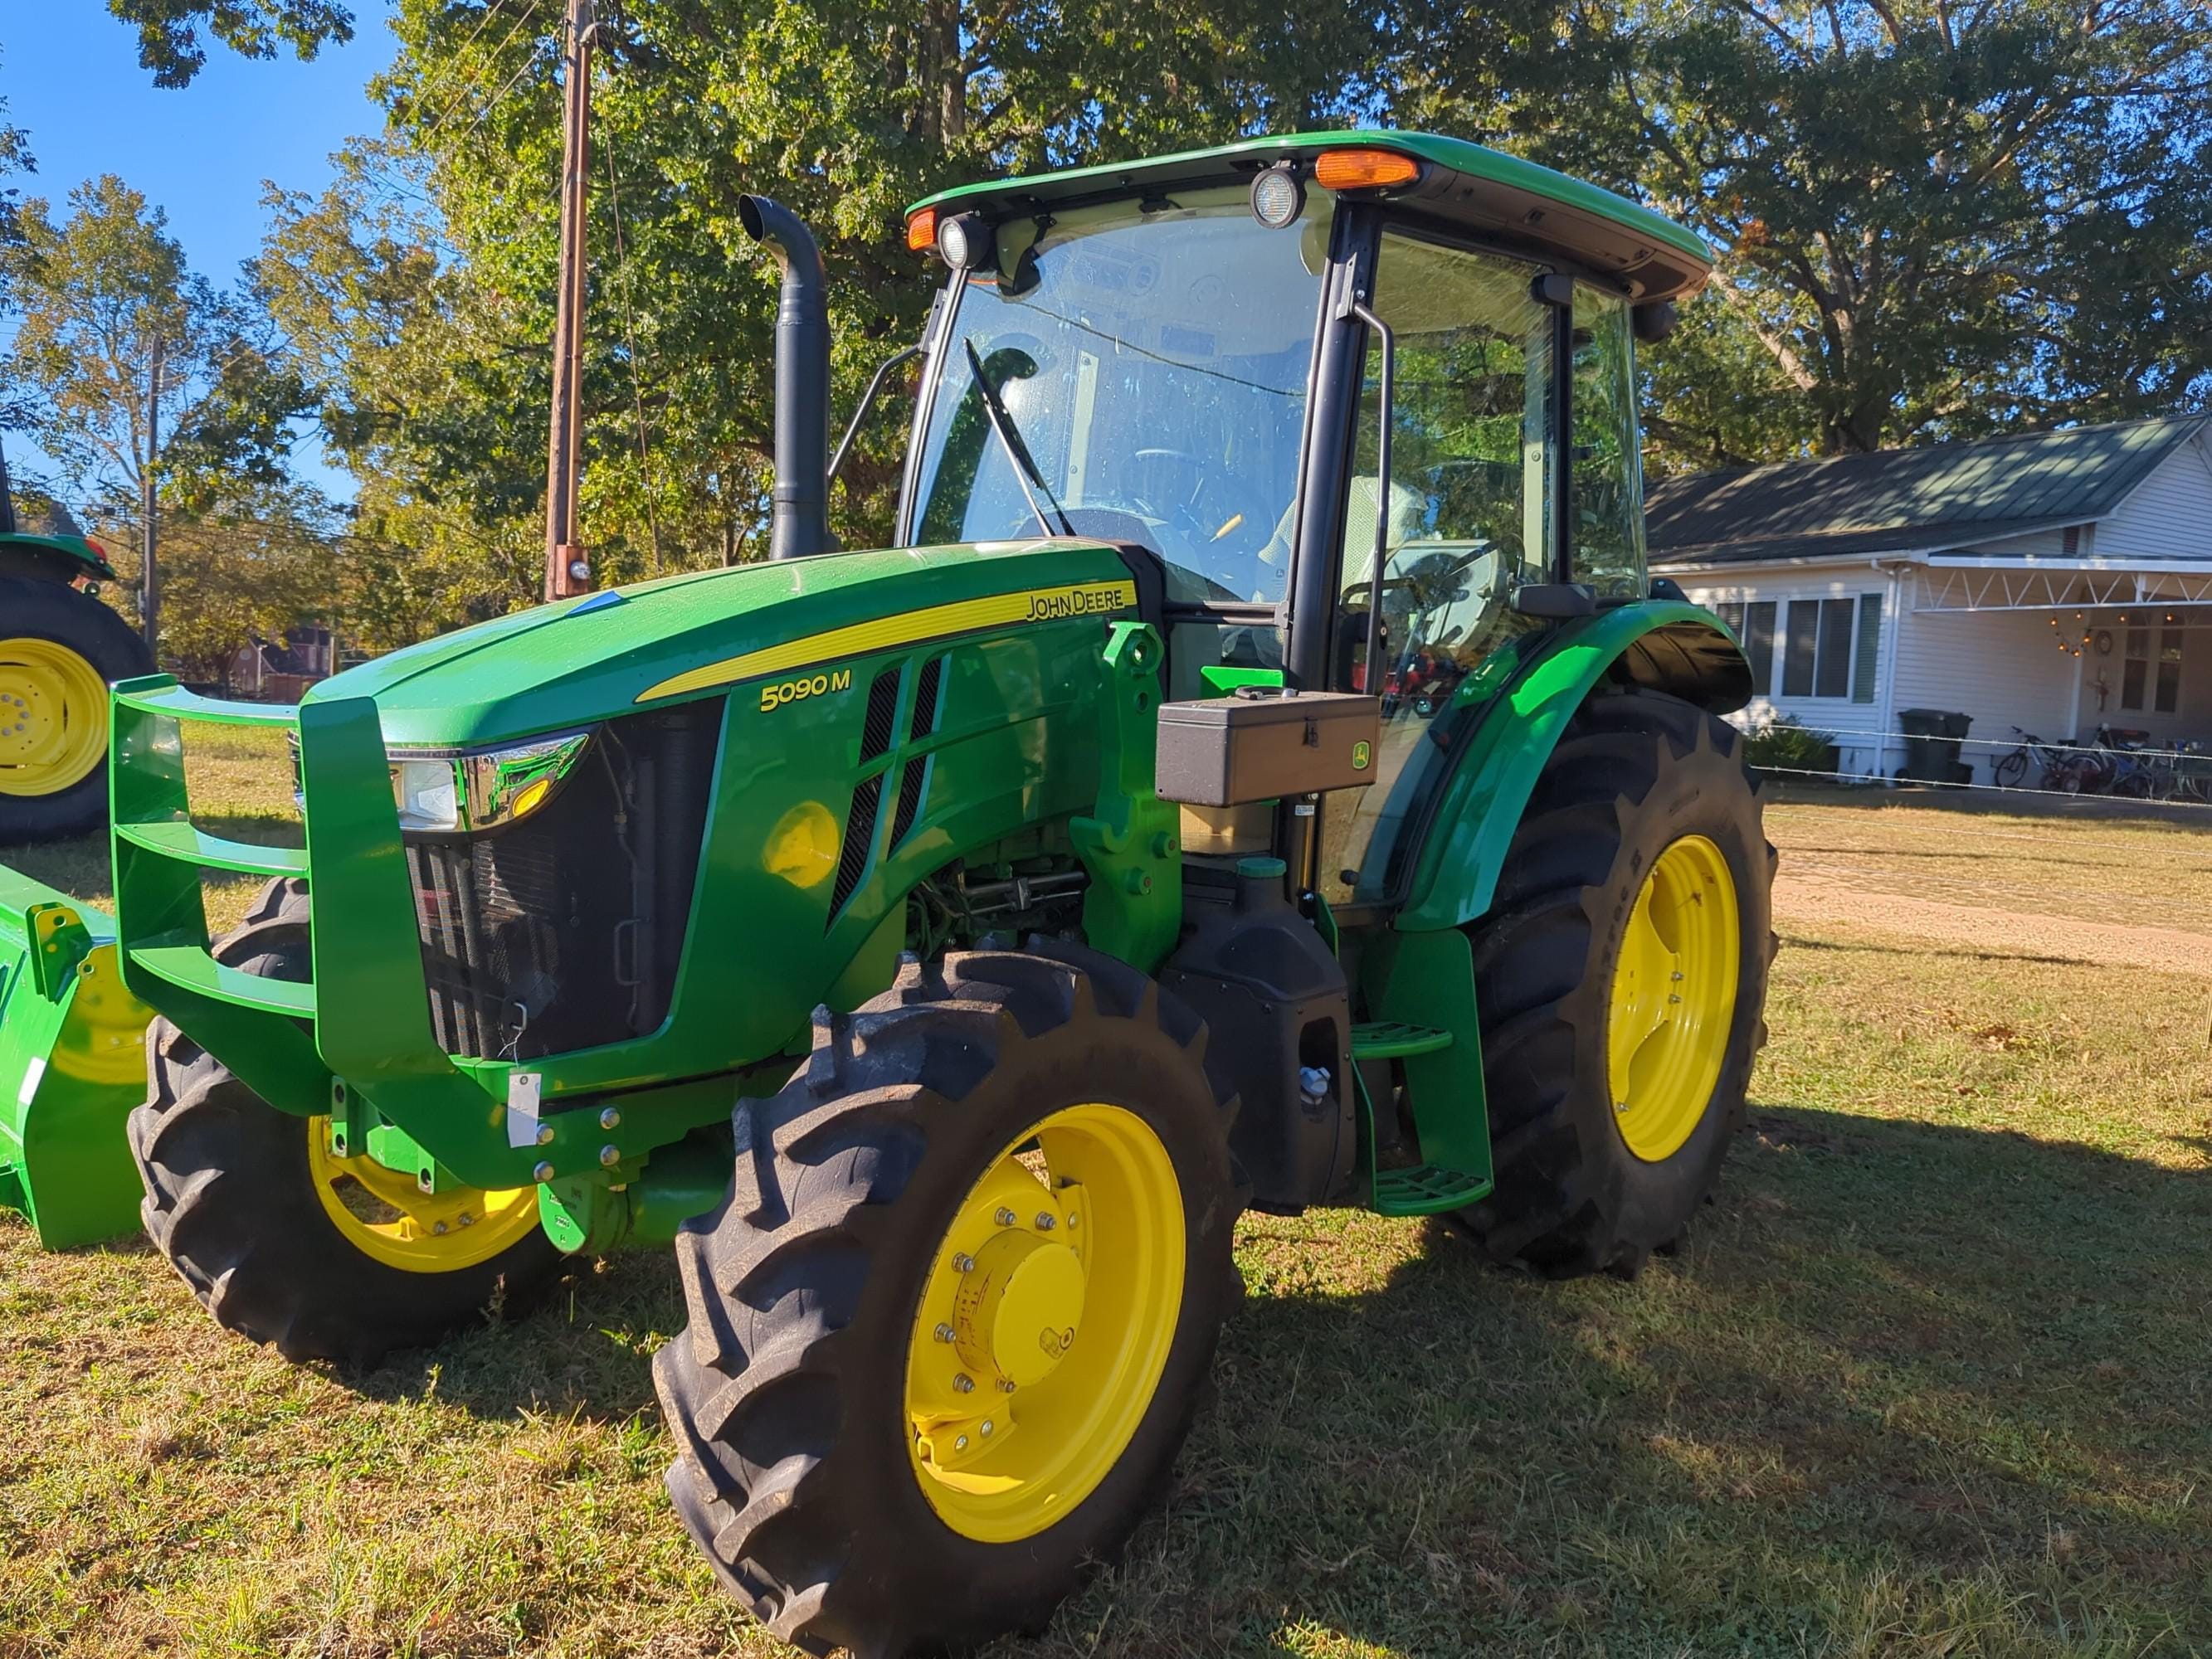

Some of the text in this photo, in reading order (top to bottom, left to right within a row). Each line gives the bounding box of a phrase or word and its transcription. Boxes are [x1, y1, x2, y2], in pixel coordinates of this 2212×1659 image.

[1026, 590, 1123, 619] JOHN DEERE
[761, 669, 850, 712] 5090 M
